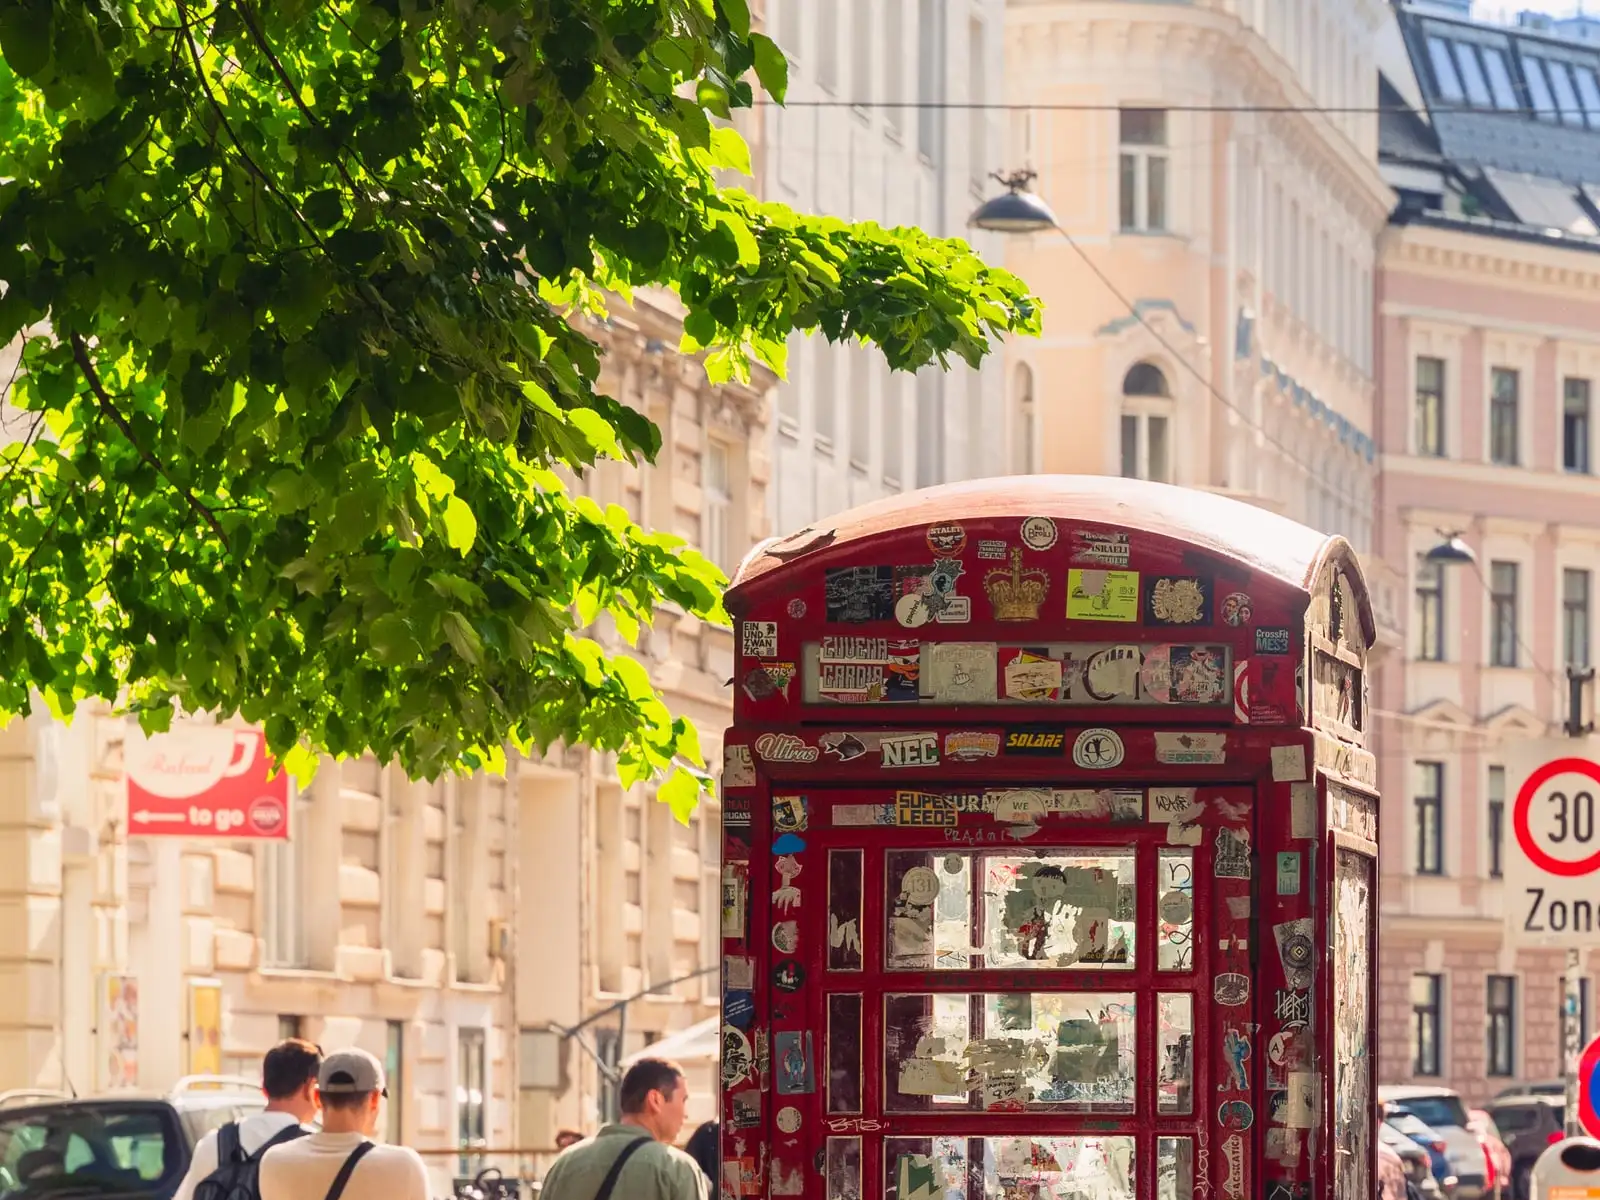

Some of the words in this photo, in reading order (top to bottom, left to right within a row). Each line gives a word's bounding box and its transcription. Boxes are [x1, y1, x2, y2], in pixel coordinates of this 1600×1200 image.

[744, 622, 759, 631] EIN
[1256, 629, 1289, 639] CrossFit
[744, 631, 764, 639] UND
[744, 639, 772, 648] ZWAN
[1006, 733, 1063, 748] SOLARE
[881, 737, 938, 767] NEC
[189, 806, 213, 826] to
[214, 808, 245, 832] go
[899, 809, 957, 825] LEEDS
[1547, 791, 1594, 843] 30
[1523, 887, 1600, 933] Zon
